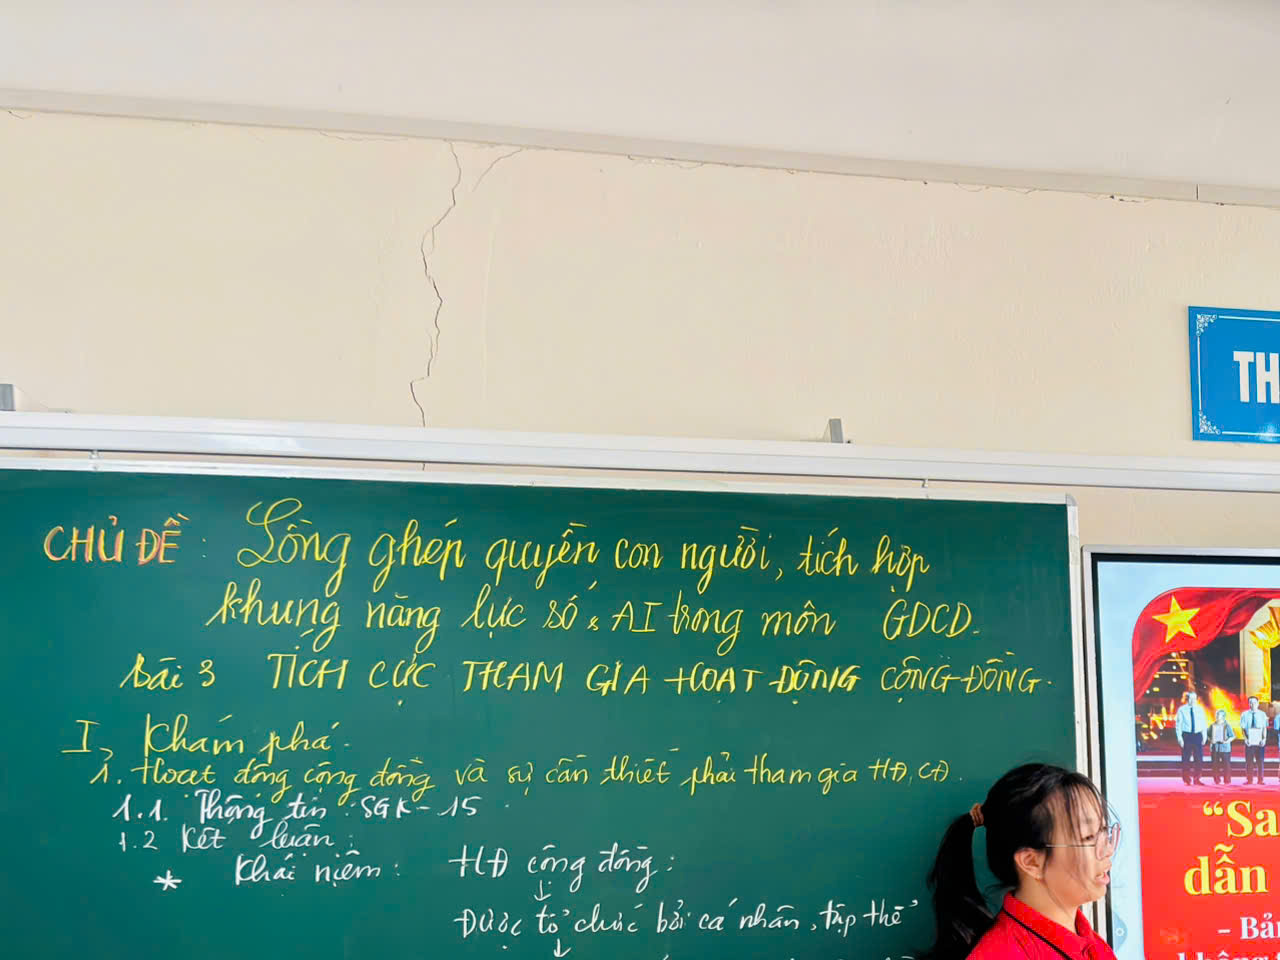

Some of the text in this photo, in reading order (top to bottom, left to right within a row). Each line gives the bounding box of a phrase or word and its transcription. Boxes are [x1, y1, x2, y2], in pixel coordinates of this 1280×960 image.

[44, 516, 123, 563] CHỦ
[237, 498, 351, 597] Lồng
[369, 519, 465, 592] ghép
[485, 522, 600, 590] quyền
[615, 538, 663, 569] con
[798, 527, 859, 577] tích
[872, 535, 930, 592] hợp
[205, 578, 341, 651] khung
[366, 594, 440, 653] năng
[461, 584, 526, 638] lực
[612, 601, 663, 632] AI
[668, 590, 740, 655] trong
[762, 601, 836, 635] môn
[199, 660, 215, 687] 3
[267, 628, 349, 690] TÍCH
[369, 654, 435, 705] CỰC
[463, 660, 562, 693] THAM
[586, 661, 650, 694] GIA
[768, 659, 861, 704] ĐỘNG
[144, 713, 243, 757] Khám
[304, 761, 361, 806] cộng
[369, 757, 435, 802] đồng
[456, 758, 488, 785] và
[507, 762, 533, 795] sự
[545, 754, 588, 785] cần
[680, 752, 737, 795] phải
[743, 753, 812, 785] tham
[817, 763, 857, 794] gia
[235, 853, 296, 886] Khái
[448, 844, 508, 878] HĐ
[1183, 844, 1268, 895] dẫn
[453, 908, 523, 950] Được
[535, 904, 570, 934] tổ
[574, 903, 644, 934] chức
[656, 899, 692, 934] bởi
[698, 897, 738, 931] cá
[819, 899, 857, 938] tập
[862, 898, 919, 927] thể
